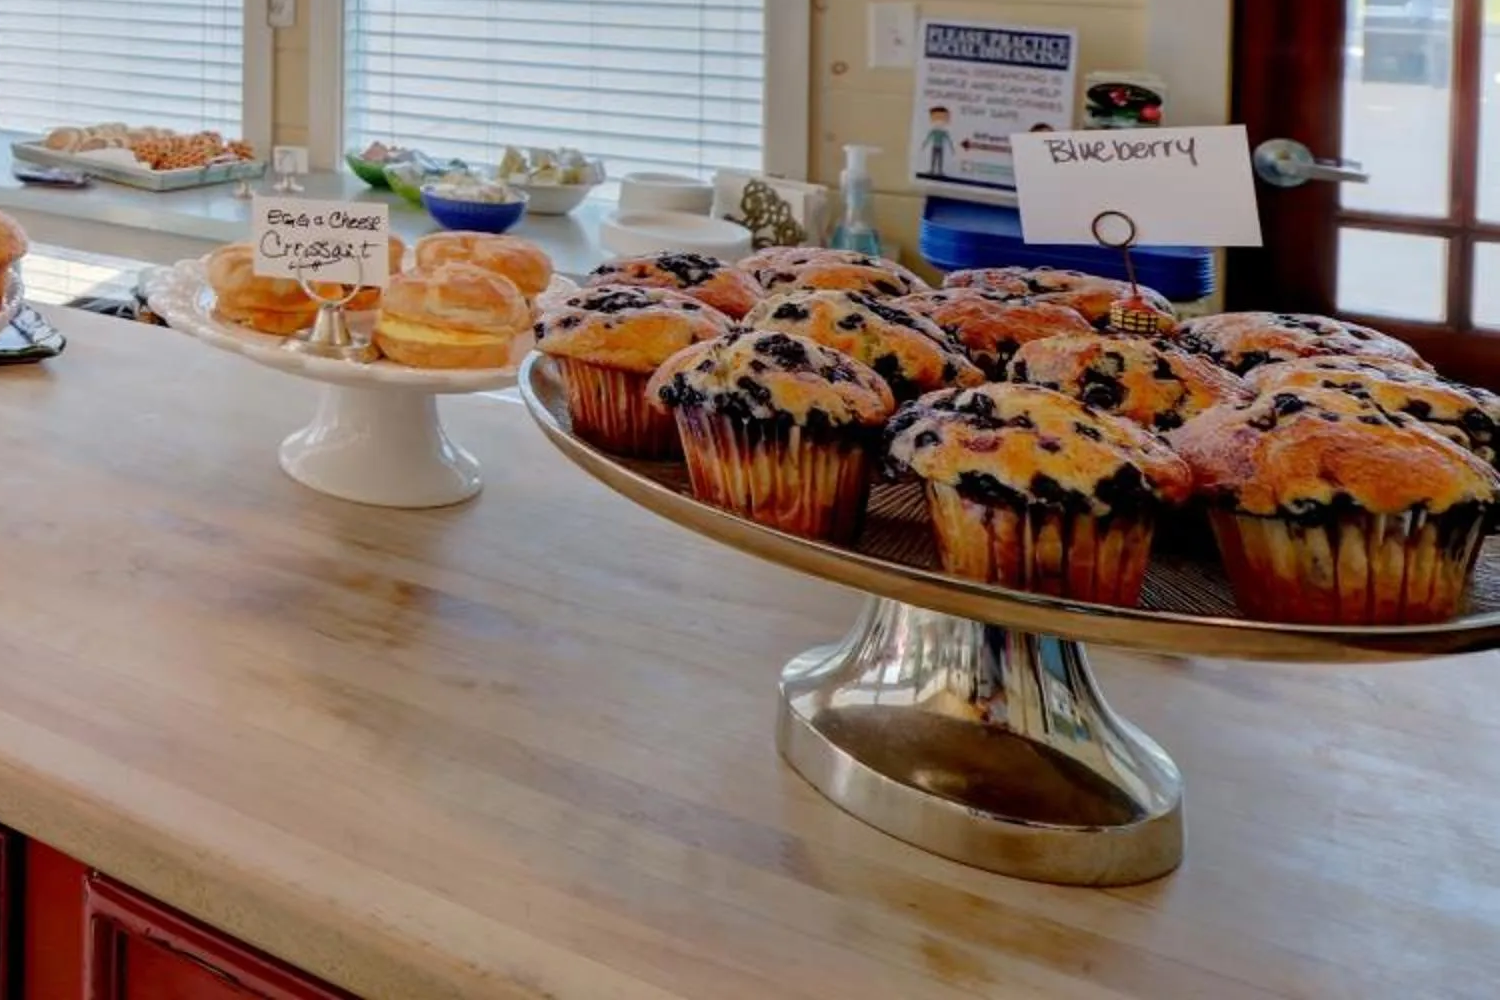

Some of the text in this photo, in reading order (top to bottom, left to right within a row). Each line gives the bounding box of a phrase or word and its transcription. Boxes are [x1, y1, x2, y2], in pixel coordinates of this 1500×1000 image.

[928, 27, 1068, 53] PLEASE PRACTICE
[979, 45, 1068, 66] DISTANCING
[1044, 136, 1199, 167] Blueberry
